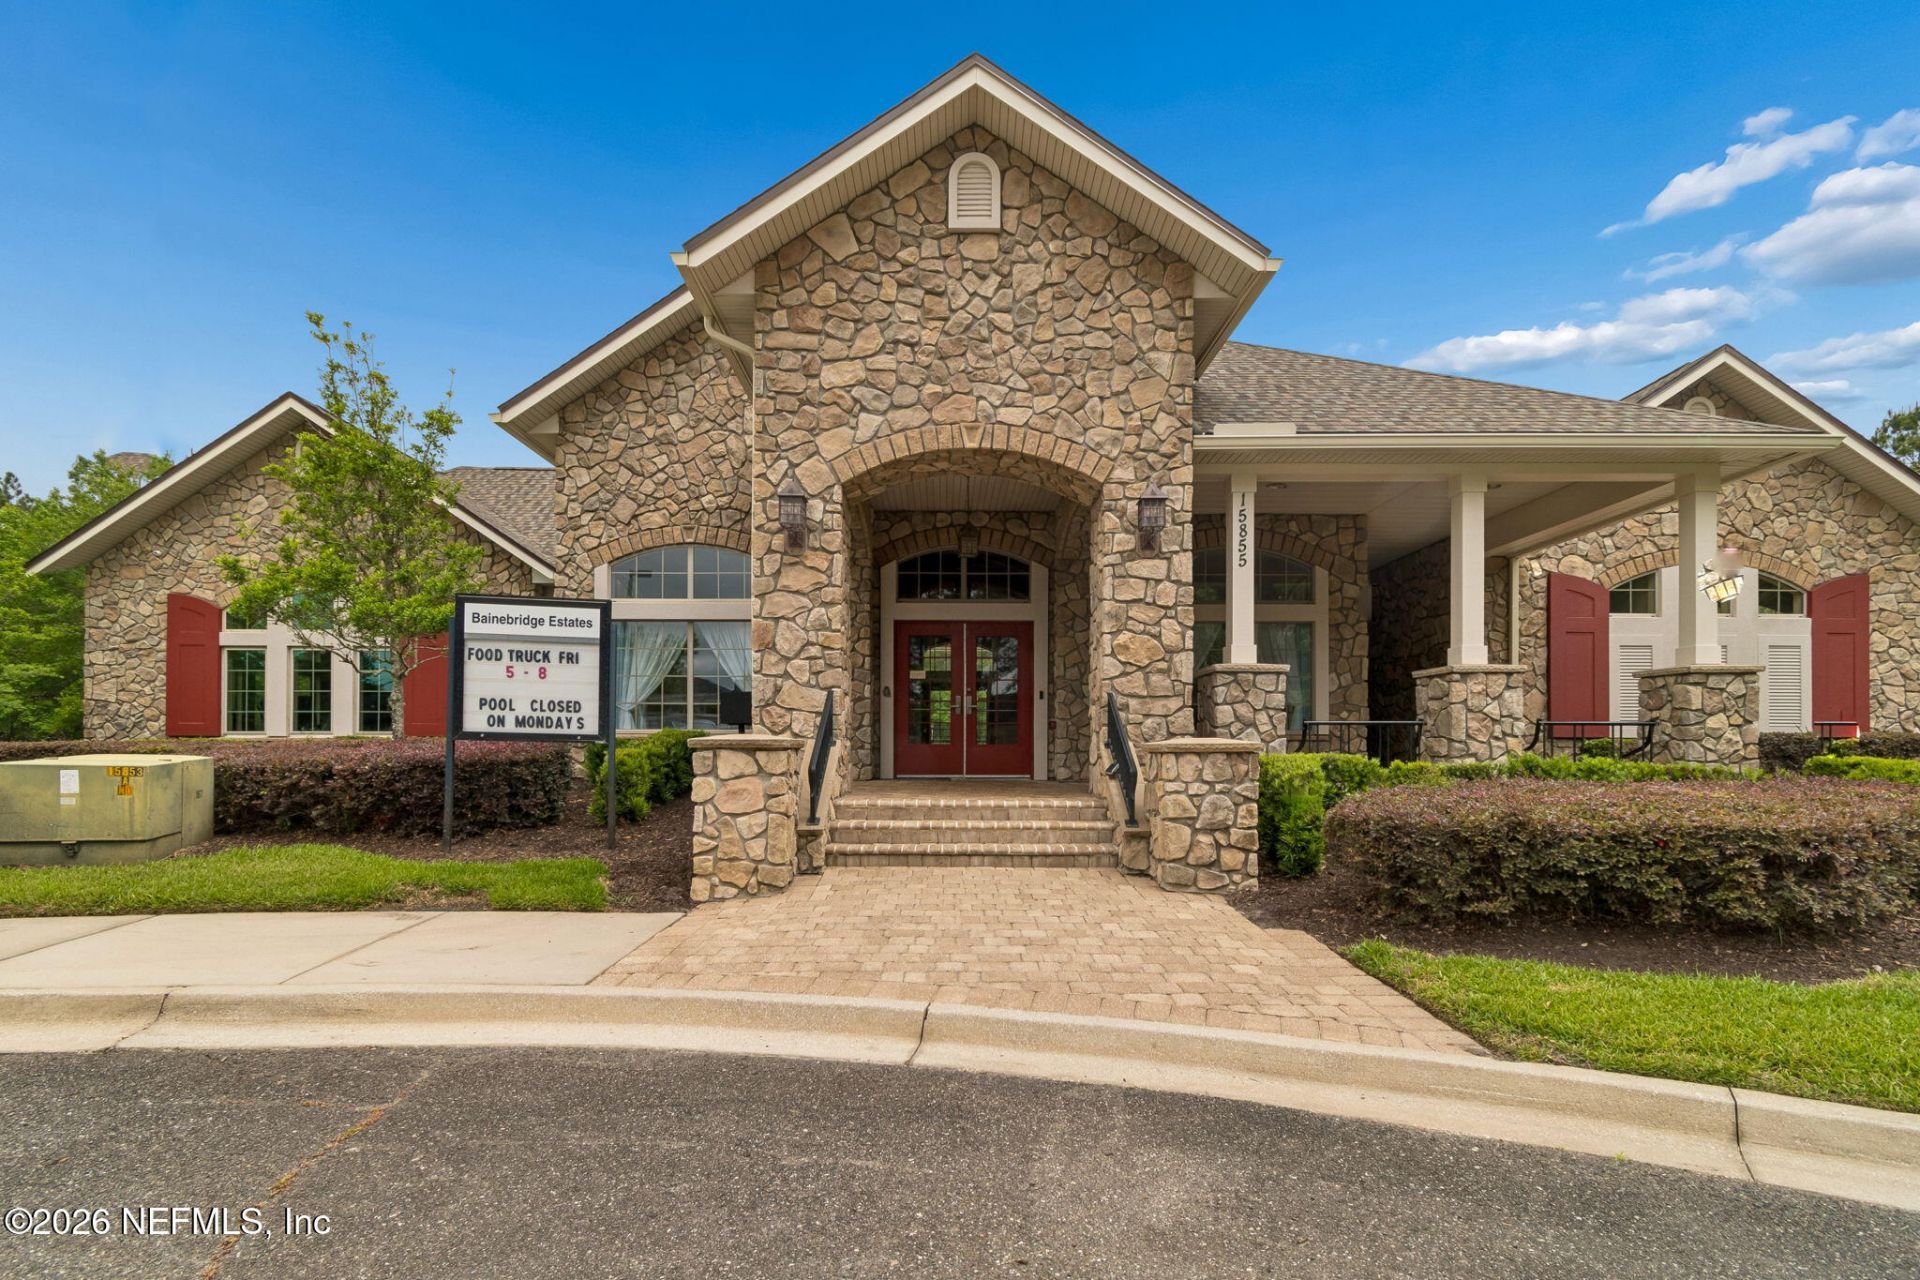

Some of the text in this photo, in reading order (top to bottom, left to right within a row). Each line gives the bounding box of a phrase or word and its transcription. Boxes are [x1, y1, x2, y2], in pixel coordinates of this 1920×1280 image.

[1238, 492, 1247, 567] 15855
[472, 612, 593, 629] Bainebridge Estates
[468, 648, 579, 664] FOOD TRUCK FRI
[479, 697, 582, 713] POOL CLOSED
[487, 714, 585, 730] ON MONDAYS
